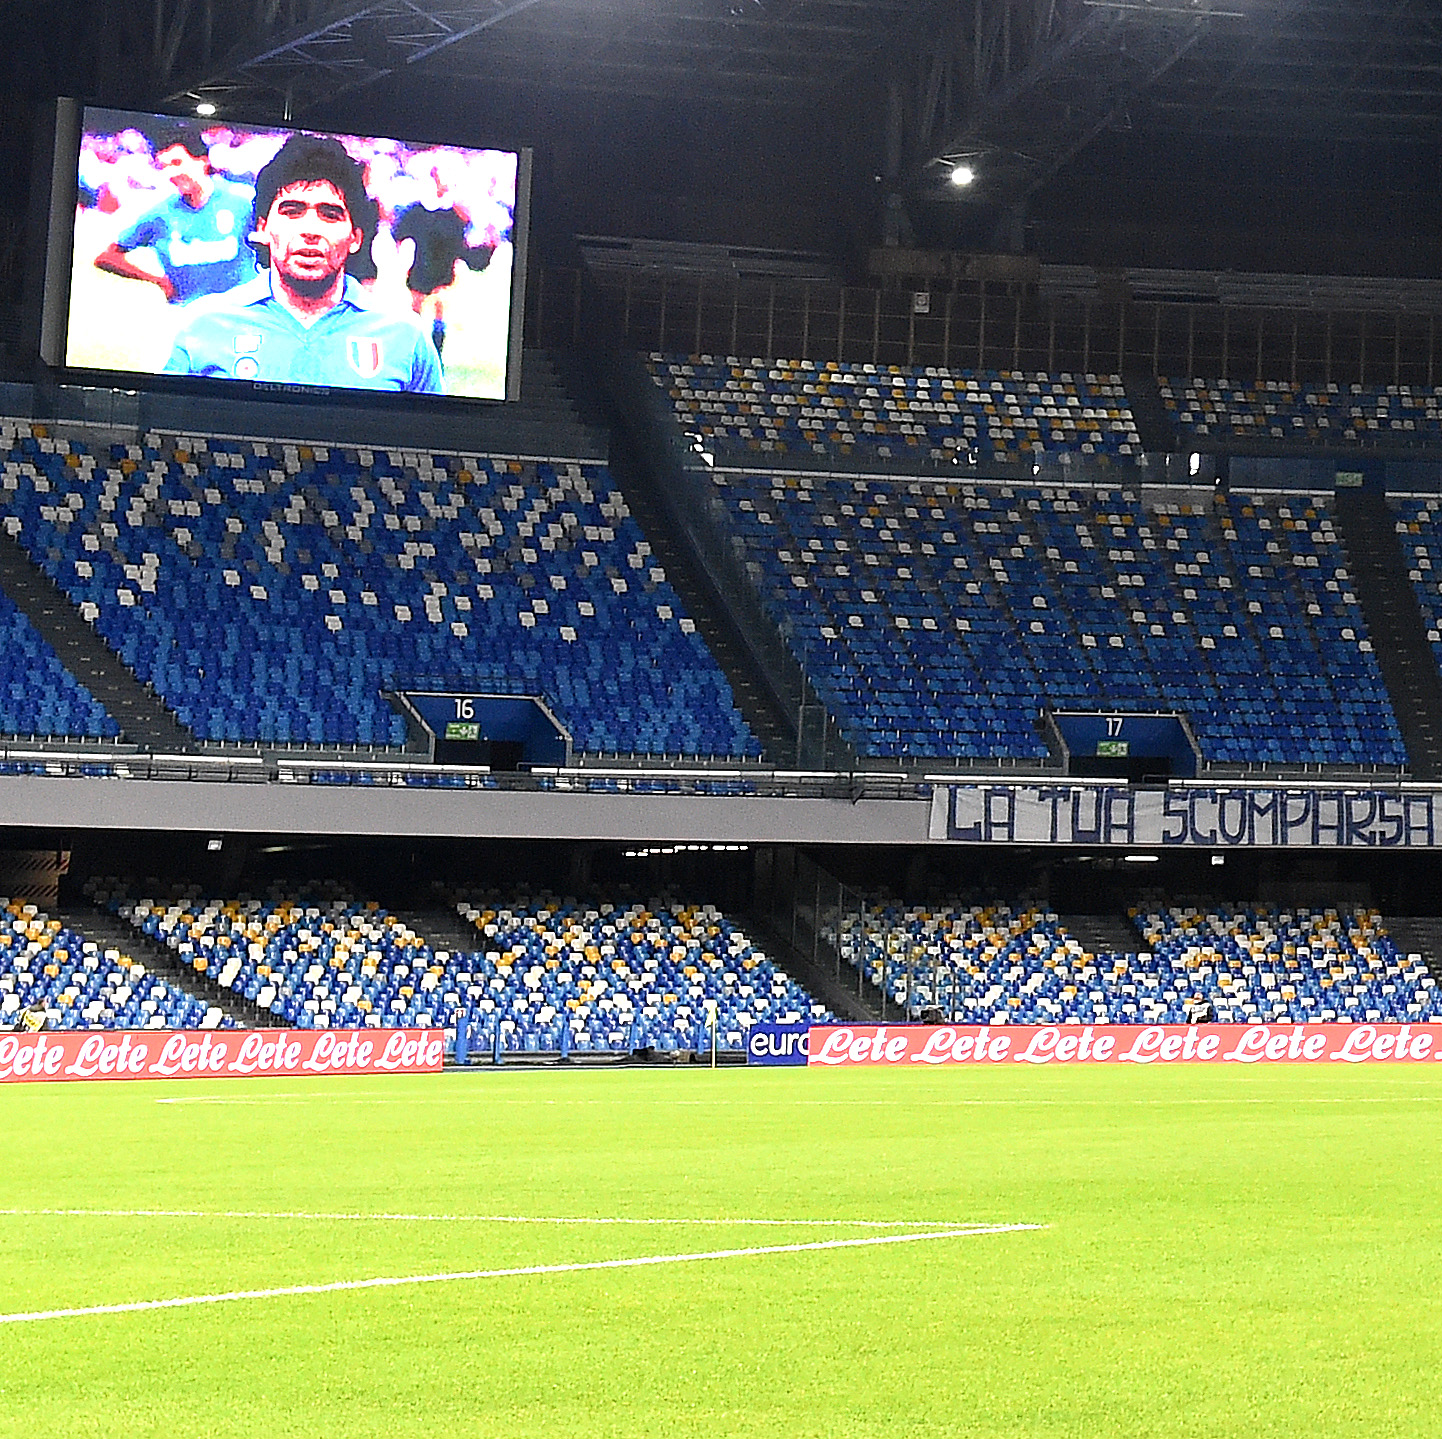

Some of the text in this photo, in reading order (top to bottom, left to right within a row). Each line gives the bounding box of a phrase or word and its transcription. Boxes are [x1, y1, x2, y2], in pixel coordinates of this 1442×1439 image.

[454, 699, 475, 719] 16
[1106, 718, 1123, 736] 17
[946, 786, 1014, 843] LA
[1039, 786, 1135, 844] TUA
[1162, 790, 1434, 845] SCOMPARSA
[65, 1034, 148, 1077] Lete
[149, 1032, 227, 1073] Lete
[228, 1032, 300, 1073] Lete
[302, 1031, 374, 1071] Lete
[374, 1030, 442, 1070] Lete
[809, 1028, 908, 1064] Lete
[910, 1027, 1010, 1064] Lete
[1013, 1027, 1115, 1064] Lete
[1118, 1026, 1220, 1063] Lete
[1224, 1025, 1326, 1063] Lete
[1330, 1025, 1432, 1062] Lete
